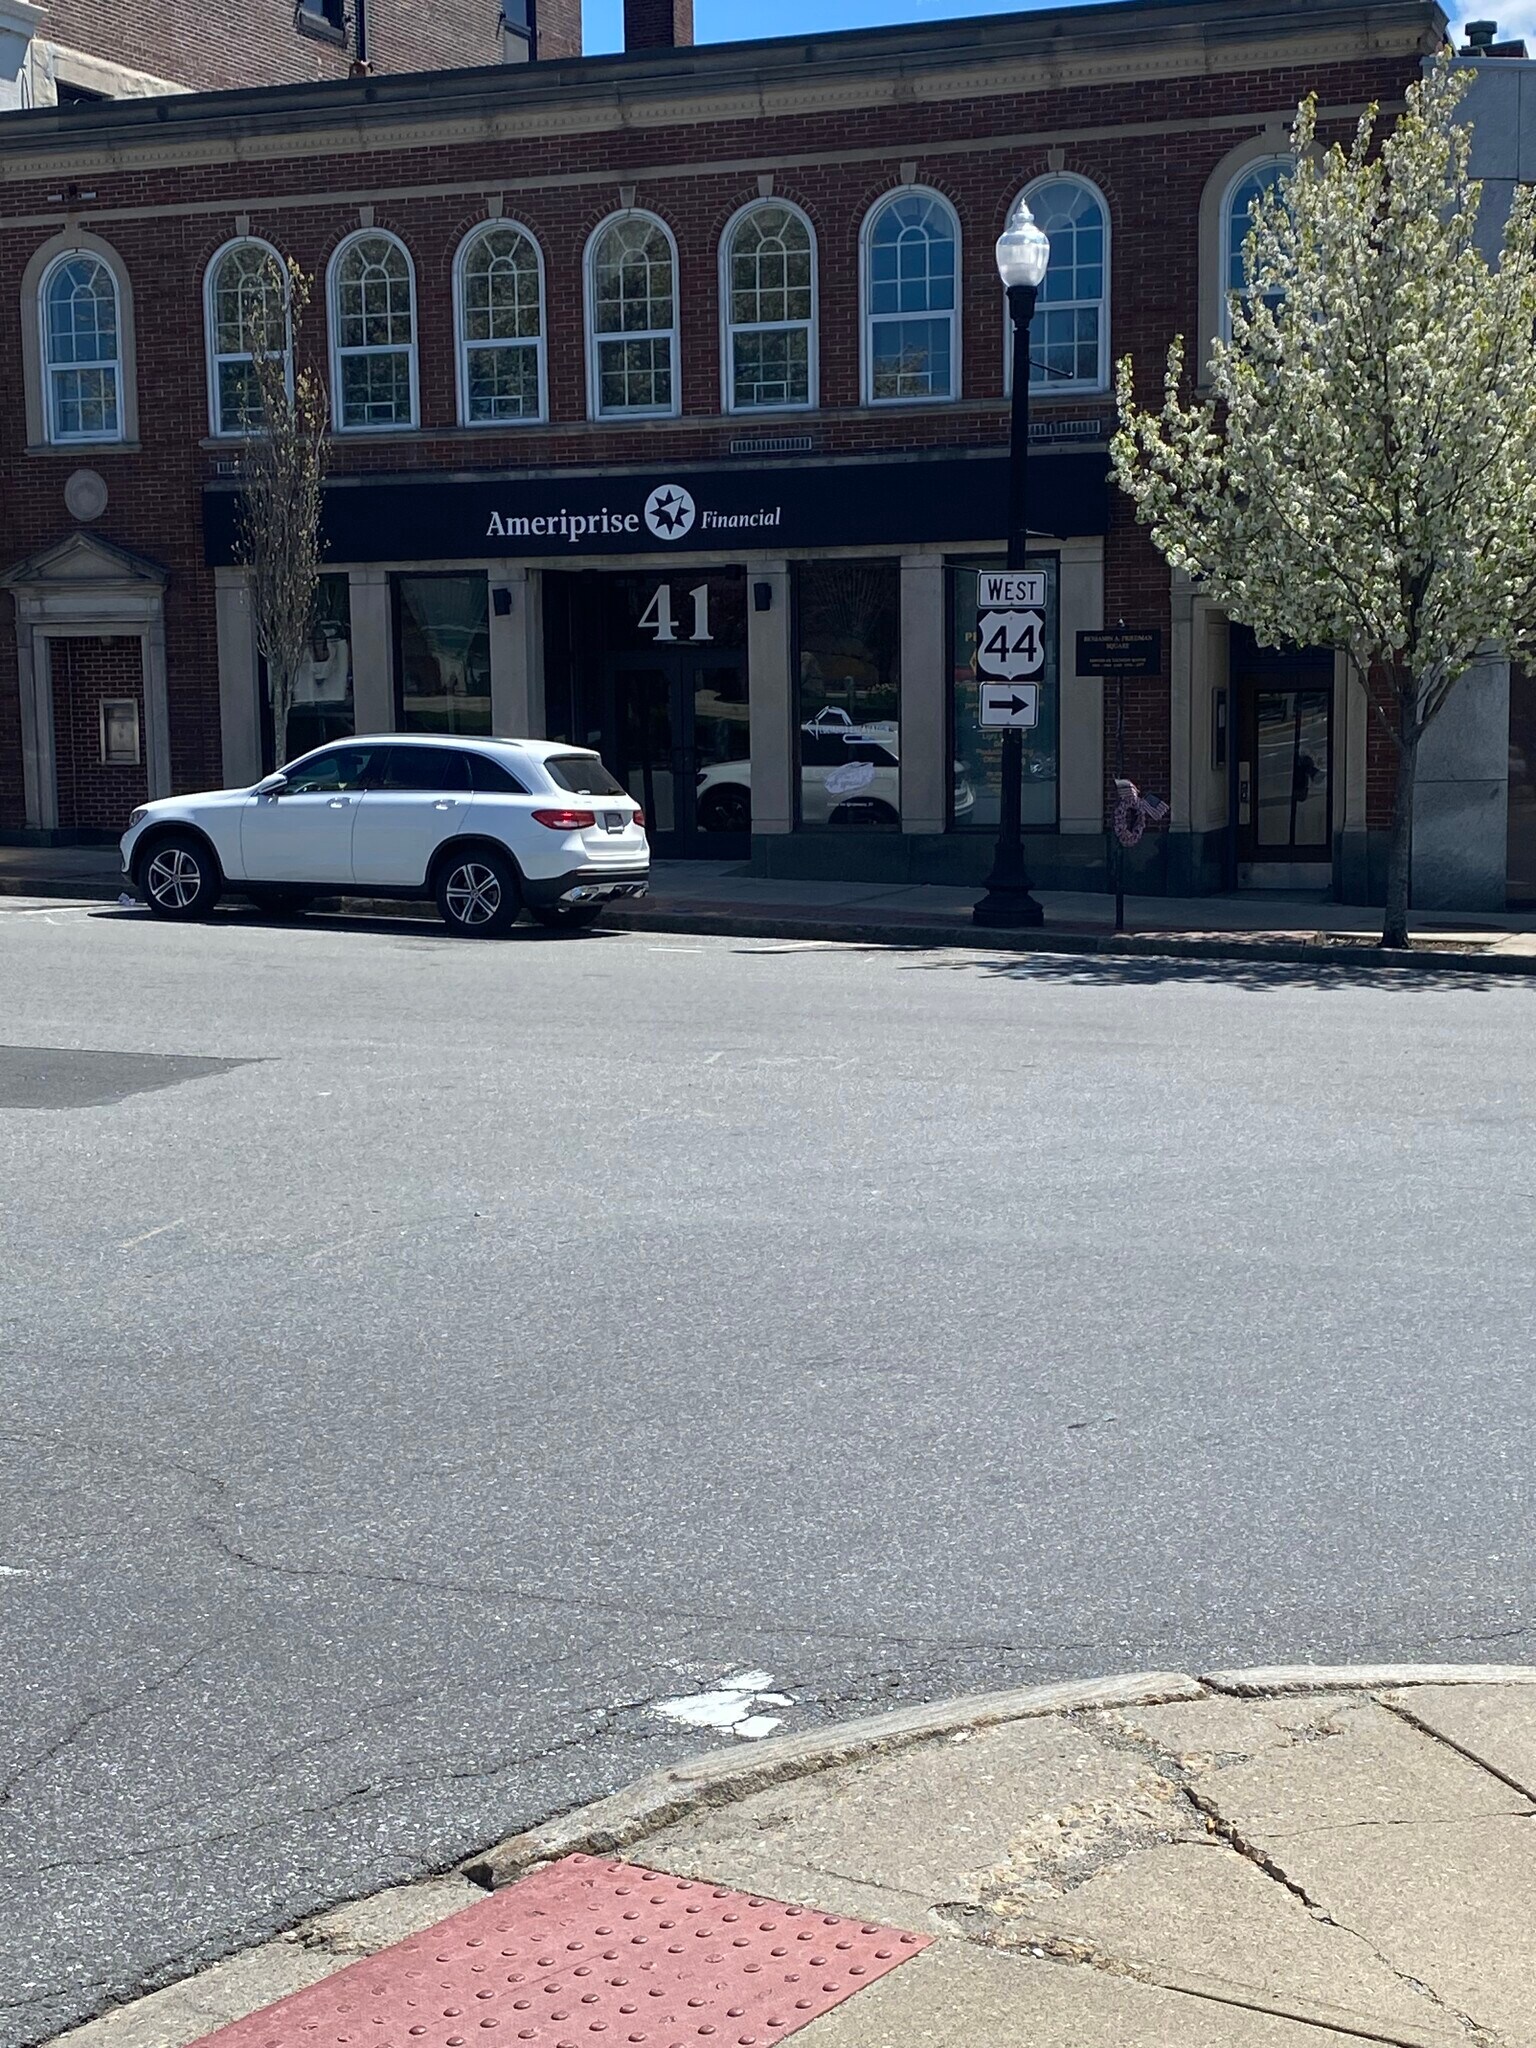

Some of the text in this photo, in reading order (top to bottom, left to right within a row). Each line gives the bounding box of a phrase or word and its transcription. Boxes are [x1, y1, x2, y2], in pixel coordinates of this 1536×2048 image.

[486, 507, 781, 543] Ameriprise Financial
[988, 579, 1037, 601] WEST
[638, 584, 714, 641] 41
[984, 625, 1037, 663] 44
